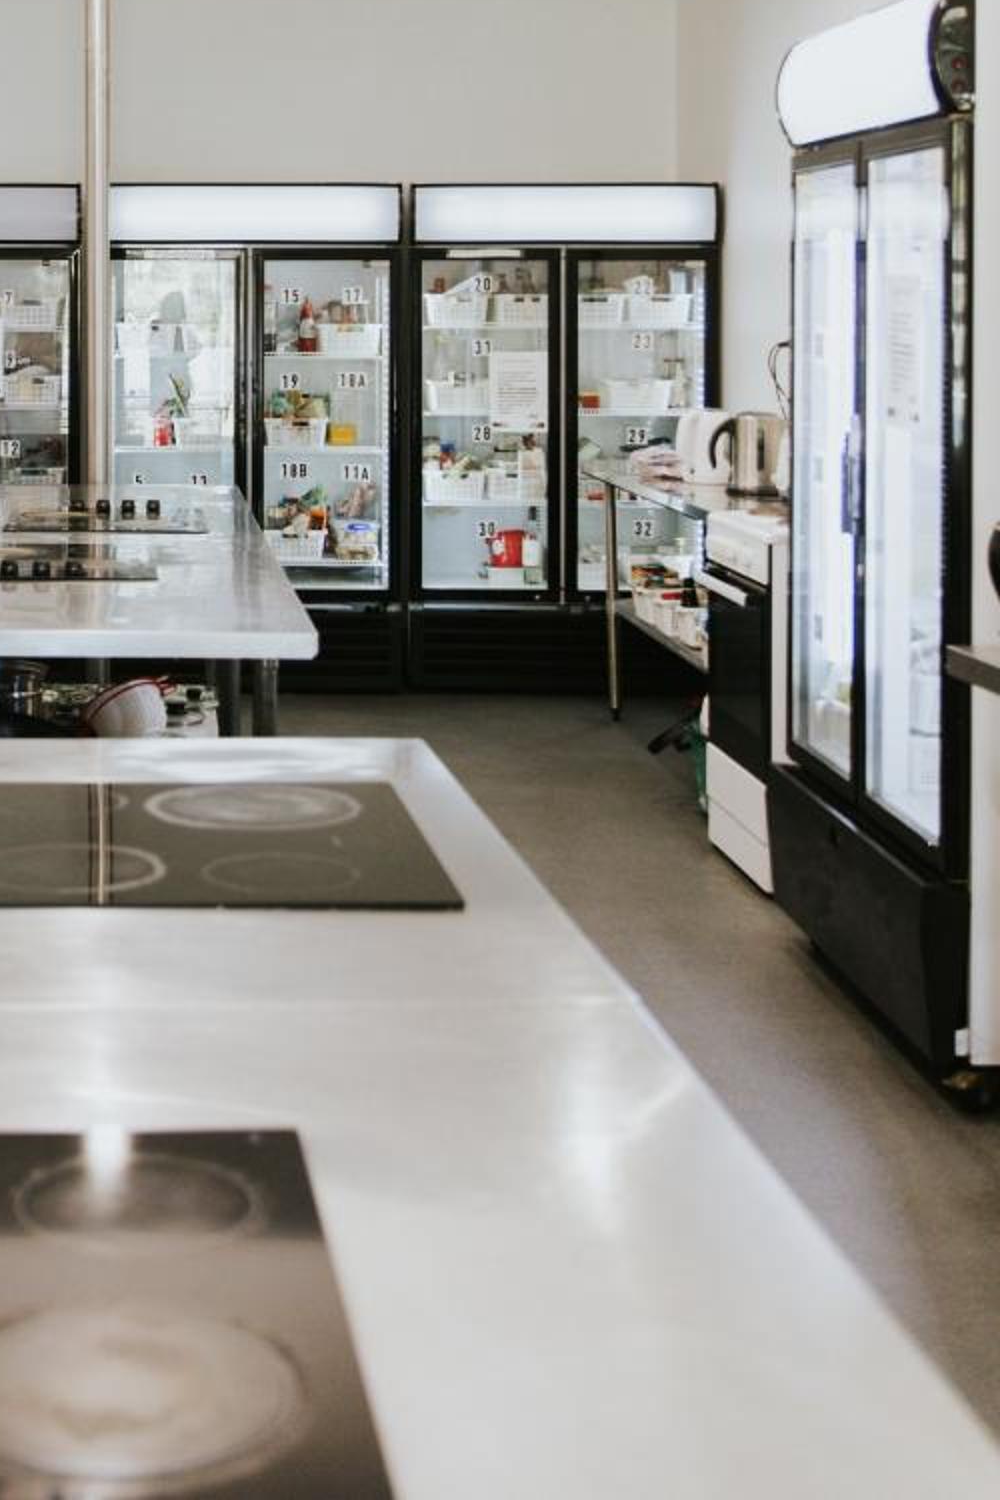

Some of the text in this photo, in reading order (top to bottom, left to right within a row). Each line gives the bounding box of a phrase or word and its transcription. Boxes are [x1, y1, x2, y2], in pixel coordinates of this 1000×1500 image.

[475, 277, 491, 292] 20
[284, 288, 299, 304] 15
[282, 374, 298, 388] 19
[474, 425, 491, 441] 28
[629, 429, 645, 443] 29
[3, 441, 19, 456] 12
[282, 463, 307, 478] 18B
[344, 464, 369, 480] 11A
[479, 521, 495, 536] 30
[635, 521, 652, 536] 32
